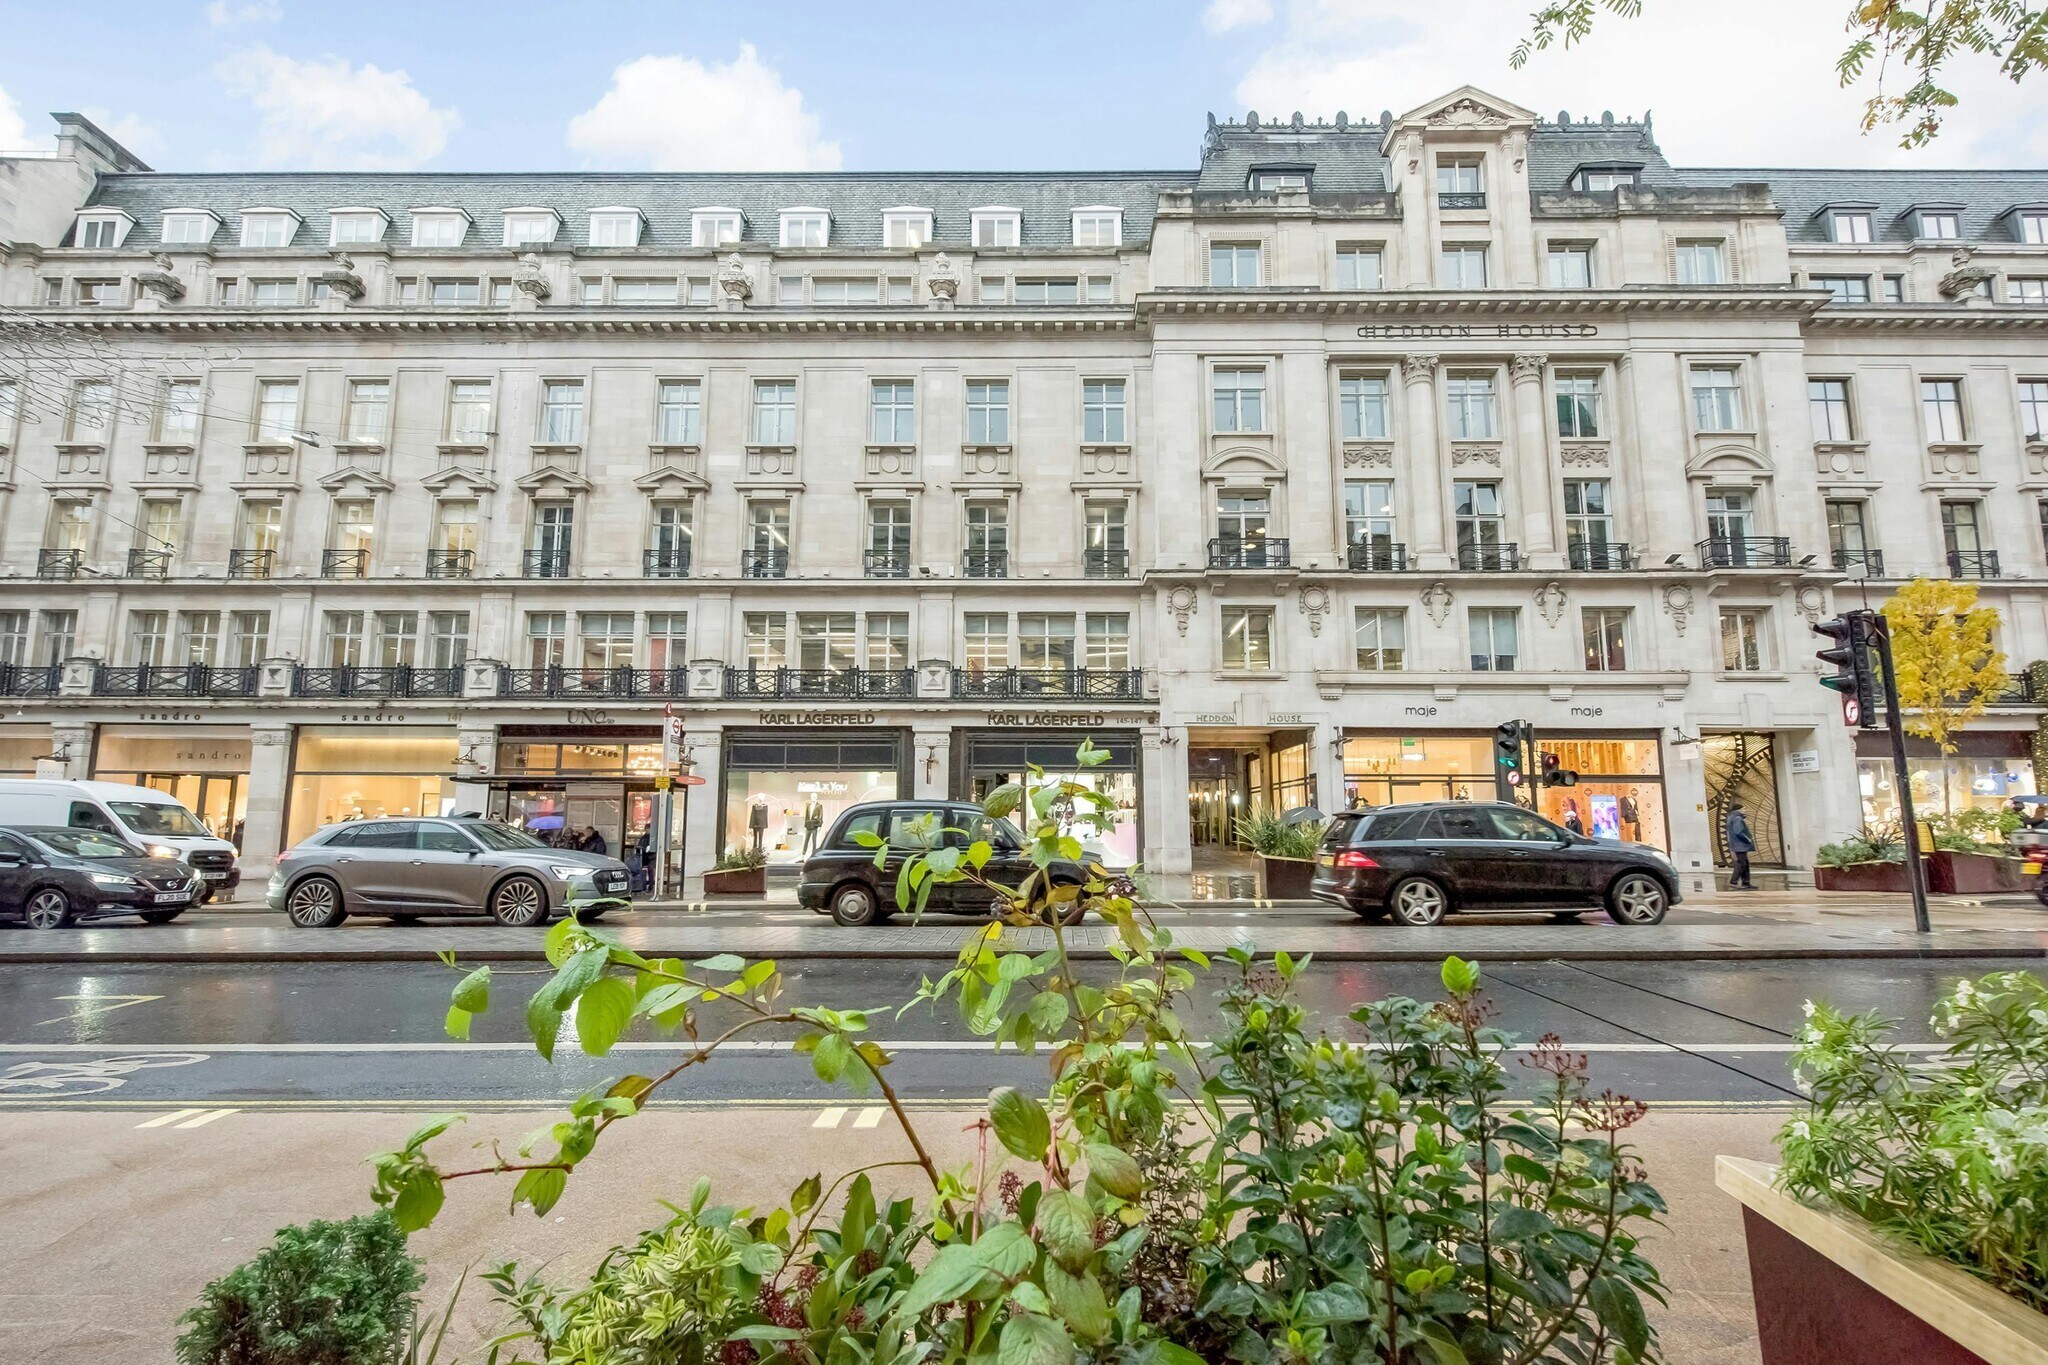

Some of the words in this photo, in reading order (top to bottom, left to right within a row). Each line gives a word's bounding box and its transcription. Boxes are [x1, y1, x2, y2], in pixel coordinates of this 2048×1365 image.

[1365, 325, 1471, 339] HEDDON
[1498, 324, 1590, 338] HOUSE
[139, 711, 201, 721] sandro
[341, 712, 405, 721] sandro
[1405, 705, 1437, 717] maje
[1571, 705, 1602, 718] maje
[759, 713, 795, 724] KARL
[796, 713, 875, 725] LAGERFELD
[988, 714, 1024, 726] KARL
[1025, 714, 1105, 726] LAGERFELD
[1196, 714, 1235, 722] HEDDON
[1269, 715, 1302, 723] HOUSE
[176, 751, 241, 760] sandro
[829, 781, 848, 791] You
